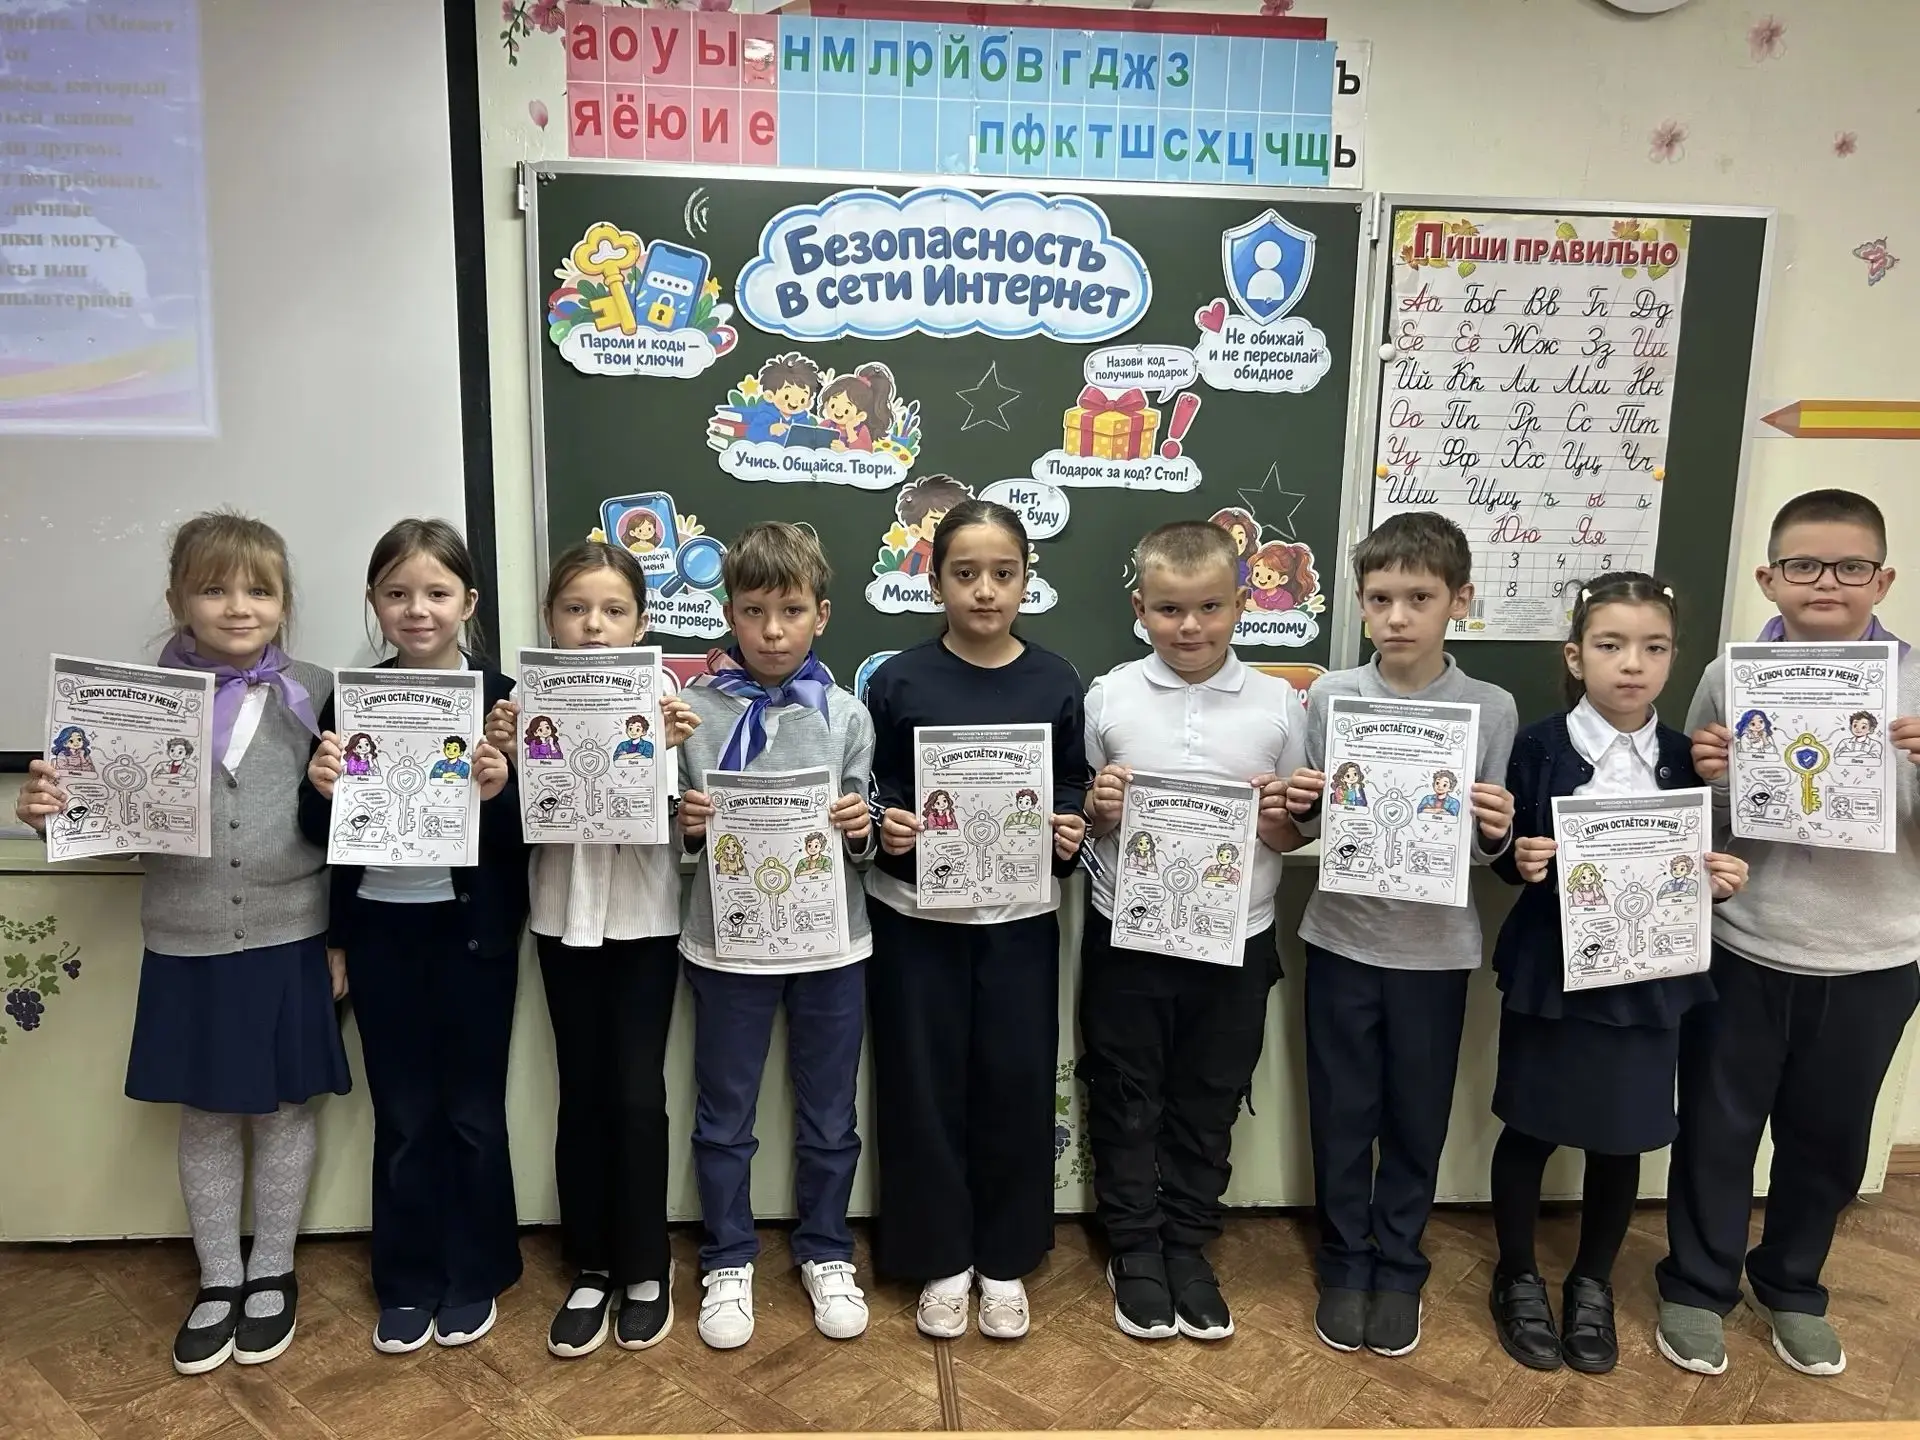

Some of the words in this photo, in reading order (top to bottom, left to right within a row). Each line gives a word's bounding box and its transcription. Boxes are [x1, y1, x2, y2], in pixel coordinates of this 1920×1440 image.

[572, 24, 598, 61] а
[609, 24, 638, 61] о
[651, 25, 679, 74] у
[698, 30, 737, 67] ы
[784, 34, 810, 72] н
[823, 37, 855, 73] м
[868, 41, 898, 77] л
[906, 41, 932, 88] р
[944, 34, 969, 79] й
[979, 34, 1007, 82] б
[1016, 46, 1043, 84] в
[1062, 50, 1082, 85] г
[1089, 47, 1119, 90] д
[1121, 52, 1157, 90] ж
[1166, 52, 1190, 87] з
[1336, 60, 1361, 95] ъ
[574, 100, 602, 136] я
[613, 94, 639, 140] ё
[647, 102, 687, 140] ю
[703, 107, 728, 144] и
[749, 110, 775, 146] е
[980, 121, 1004, 154] п
[1011, 113, 1045, 165] ф
[1055, 124, 1077, 158] к
[1088, 124, 1113, 158] т
[1121, 124, 1155, 159] ш
[1163, 128, 1189, 162] с
[1195, 129, 1222, 164] х
[1227, 132, 1254, 175] ц
[1265, 132, 1289, 166] ч
[1294, 133, 1328, 176] щ
[1333, 135, 1356, 169] ь
[785, 225, 1106, 276] Безопасность
[775, 281, 809, 319] в
[816, 271, 912, 309] сети
[923, 264, 1130, 318] Интернет
[1399, 282, 1443, 313] Аа
[1464, 283, 1507, 314] Бб
[1523, 286, 1560, 316] Вв
[1630, 289, 1673, 328] Дд
[580, 334, 635, 351] Пароли
[638, 339, 646, 349] и
[651, 339, 686, 352] коды
[1225, 327, 1244, 345] Не
[1250, 331, 1304, 347] обижай
[1398, 321, 1424, 351] Ее
[1455, 320, 1480, 353] Ёё
[1499, 324, 1559, 355] Жж
[1581, 328, 1616, 369] Зз
[1631, 329, 1669, 358] Ии
[594, 353, 631, 365] твои
[636, 354, 683, 367] ключи
[1106, 356, 1143, 367] Назови
[1147, 356, 1165, 368] код
[1209, 350, 1217, 361] и
[1222, 350, 1238, 361] не
[1244, 350, 1318, 366] пересылай
[1095, 370, 1144, 381] получишь
[1147, 368, 1188, 379] подарок
[1234, 368, 1293, 382] обидное
[1396, 357, 1433, 390] Йй
[1446, 362, 1485, 391] Кк
[1500, 364, 1540, 393] Лл
[1553, 364, 1611, 394] Мм
[1627, 366, 1663, 396] Нн
[1390, 399, 1424, 428] Оо
[1441, 400, 1480, 429] Пп
[1509, 402, 1541, 440] Рр
[1566, 403, 1593, 431] Сс
[1609, 404, 1660, 433] Тт
[735, 450, 780, 469] Учись.
[782, 456, 847, 475] Общайся.
[849, 459, 897, 479] Твори.
[1387, 436, 1421, 474] Уу
[1439, 438, 1480, 477] Фф
[1501, 440, 1544, 468] Хх
[1563, 441, 1603, 477] Цц
[1622, 442, 1653, 471] Чч
[1049, 460, 1103, 479] Подарок
[1107, 468, 1120, 478] за
[1124, 466, 1151, 481] код?
[1154, 466, 1189, 482] Стоп!
[1009, 488, 1040, 506] Нет,
[1385, 476, 1439, 504] Шш
[1467, 477, 1521, 512] Щщ
[1587, 493, 1606, 507] ы
[1027, 509, 1060, 528] буду
[1491, 515, 1541, 543] Юю
[1571, 516, 1606, 544] Яя
[1509, 552, 1519, 568] 3
[1556, 553, 1566, 569] 4
[1601, 554, 1611, 570] 5
[1506, 582, 1517, 597] 8
[1552, 582, 1563, 598] 9
[678, 599, 711, 614] имя?
[670, 615, 724, 631] проверь
[1235, 621, 1307, 638] зрослому
[543, 676, 566, 688] КЛЮЧ
[567, 673, 604, 684] ОСТАЁТСЯ
[605, 676, 611, 684] У
[611, 676, 632, 688] МЕНЯ
[1757, 671, 1783, 683] КЛЮЧ
[1784, 666, 1826, 677] ОСТАЁТСЯ
[1827, 669, 1834, 678] У
[1835, 670, 1859, 683] МЕНЯ
[80, 689, 104, 699] КЛЮЧ
[107, 688, 147, 700] ОСТАЁТСЯ
[147, 694, 155, 702] У
[155, 696, 178, 710] МЕНЯ
[363, 695, 386, 706] КЛЮЧ
[389, 692, 424, 702] ОСТАЁТСЯ
[431, 696, 452, 709] МЕНЯ
[1355, 724, 1378, 735] КЛЮЧ
[1379, 723, 1416, 734] ОСТАЁТСЯ
[1417, 726, 1423, 735] У
[1423, 728, 1445, 741] МЕНЯ
[941, 750, 963, 764] КЛЮЧ
[964, 747, 997, 759] ОСТАЁТСЯ
[998, 750, 1004, 758] У
[1004, 751, 1023, 763] МЕНЯ
[729, 797, 749, 809] КЛЮЧ
[750, 795, 782, 805] ОСТАЁТСЯ
[783, 797, 789, 806] У
[790, 797, 810, 807] МЕНЯ
[1148, 799, 1169, 808] КЛЮЧ
[1170, 798, 1204, 810] ОСТАЁТСЯ
[1204, 803, 1211, 811] У
[1210, 805, 1229, 818] МЕНЯ
[1584, 822, 1609, 836] КЛЮЧ
[1610, 816, 1649, 829] ОСТАЁТСЯ
[1650, 818, 1656, 828] У
[1656, 819, 1679, 830] МЕНЯ
